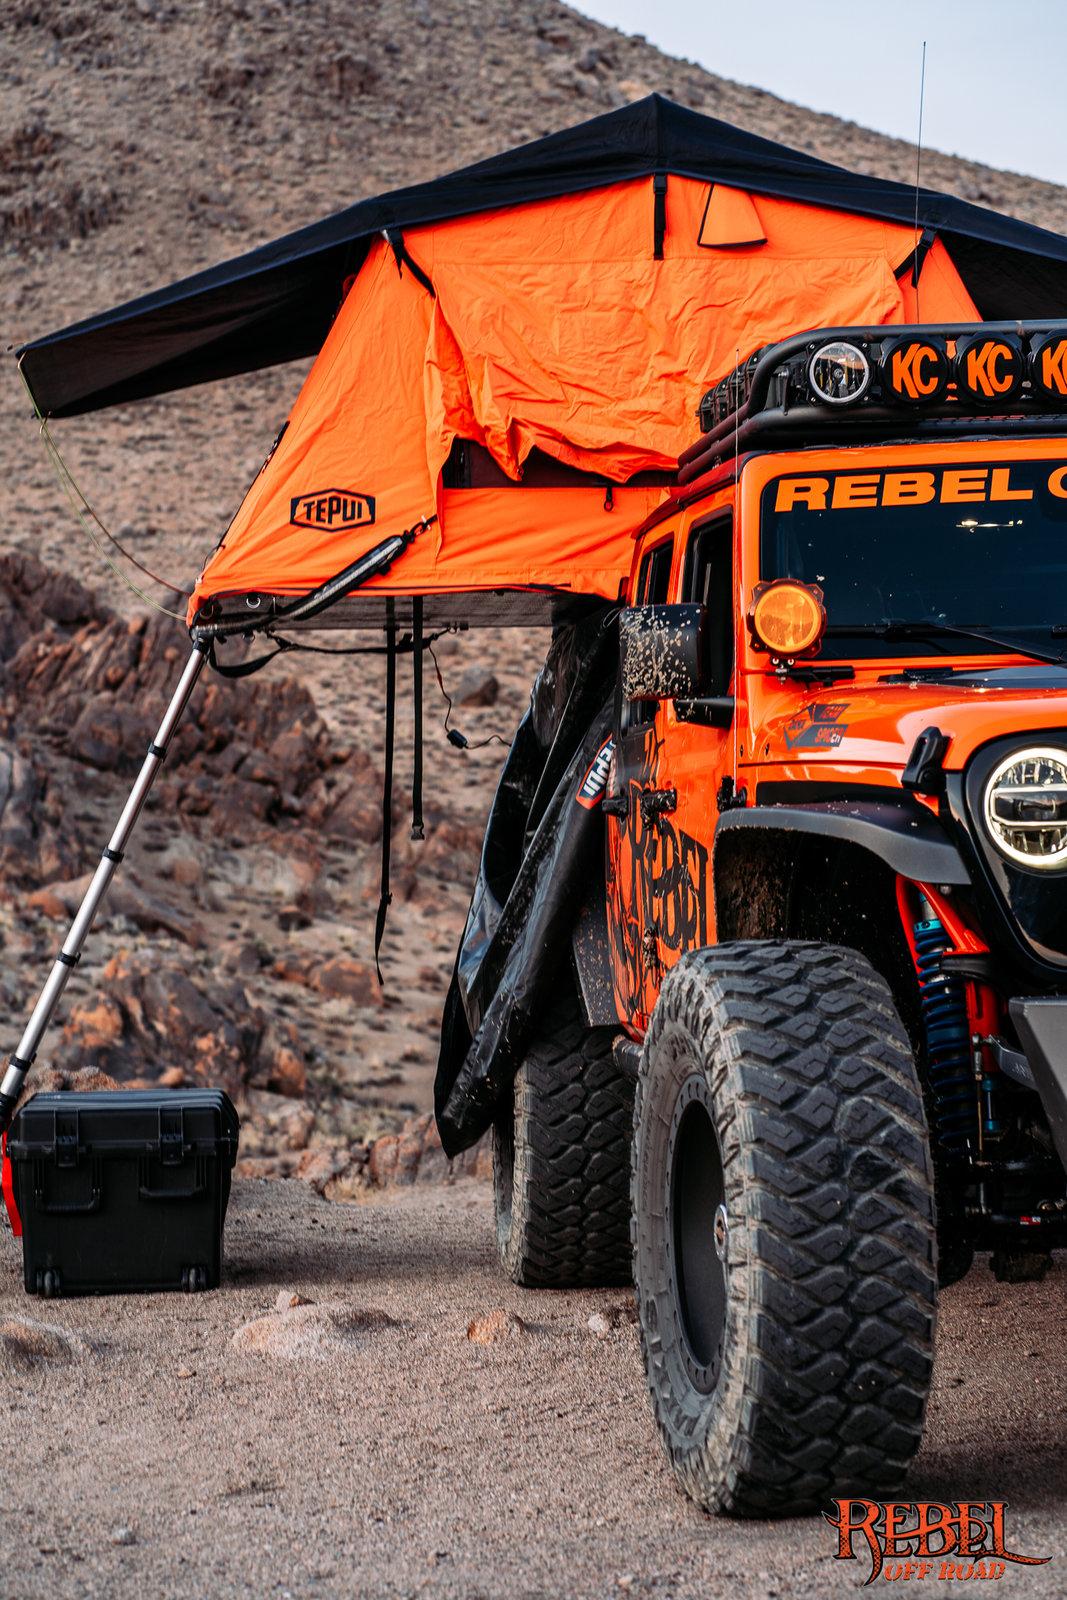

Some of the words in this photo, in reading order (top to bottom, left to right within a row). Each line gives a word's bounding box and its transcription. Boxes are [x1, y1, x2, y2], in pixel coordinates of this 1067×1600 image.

[892, 343, 939, 399] KC
[967, 341, 1014, 397] KC
[1042, 339, 1067, 395] K
[303, 496, 363, 525] TEPUI
[774, 468, 1034, 512] REBEL
[583, 740, 617, 796] EPUI
